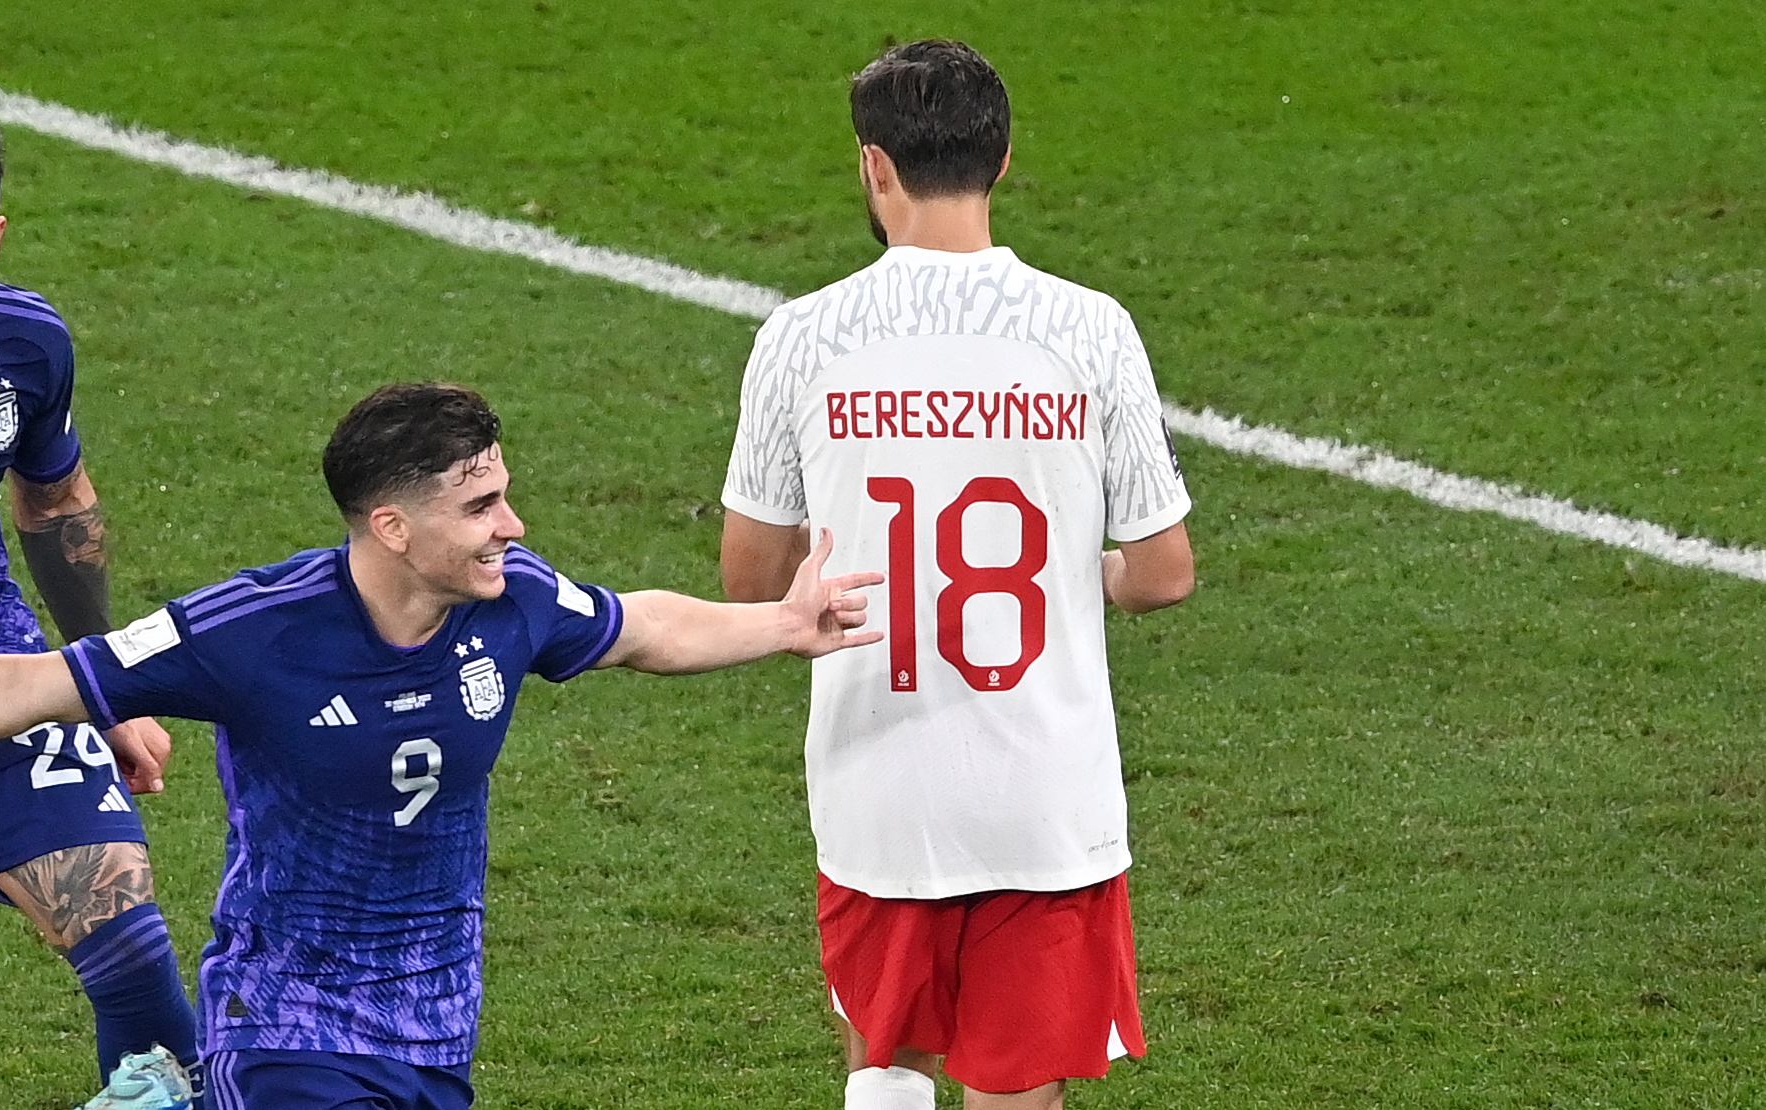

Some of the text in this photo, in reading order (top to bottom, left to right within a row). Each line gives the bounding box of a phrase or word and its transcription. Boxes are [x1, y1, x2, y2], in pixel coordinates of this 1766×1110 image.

[826, 382, 1088, 441] BERESZYŃSKI
[866, 475, 1048, 693] 18
[11, 721, 121, 790] 24
[391, 737, 442, 827] 9
